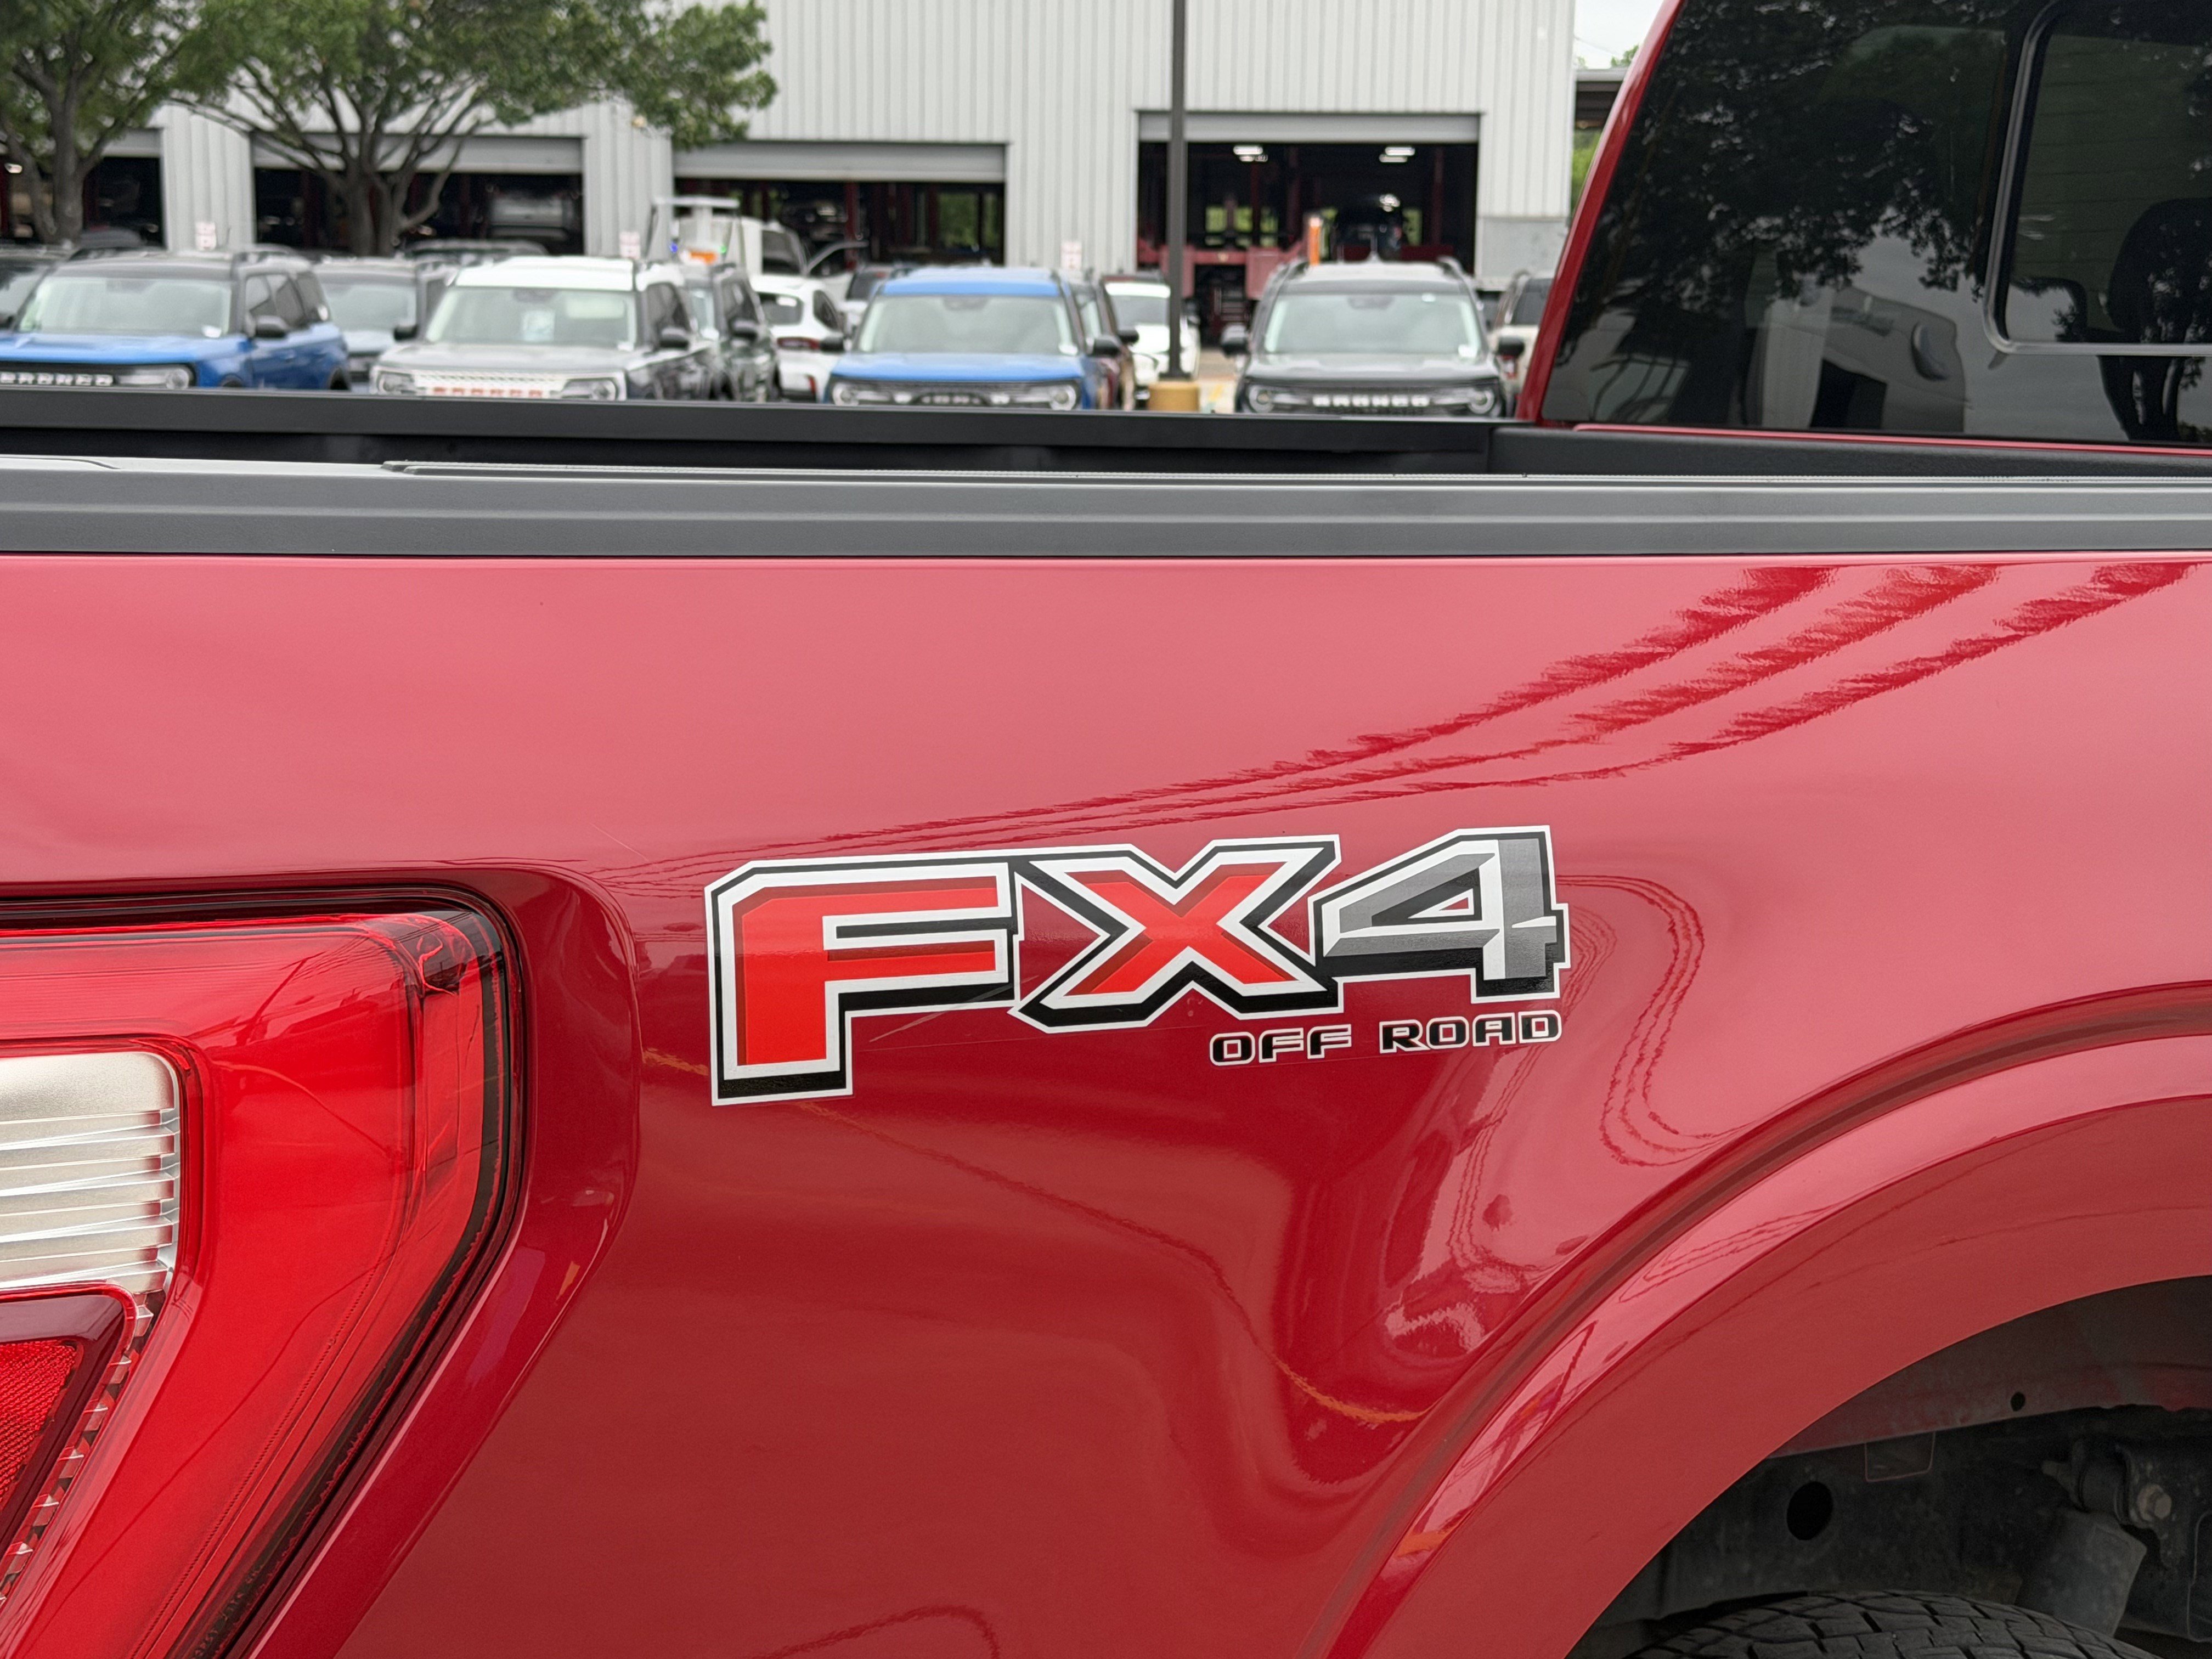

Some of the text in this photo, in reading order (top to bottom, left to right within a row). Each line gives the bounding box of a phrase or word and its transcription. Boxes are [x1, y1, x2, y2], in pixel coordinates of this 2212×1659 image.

[704, 825, 1570, 1106] FX4
[1210, 1009, 1562, 1066] OFF ROAD
